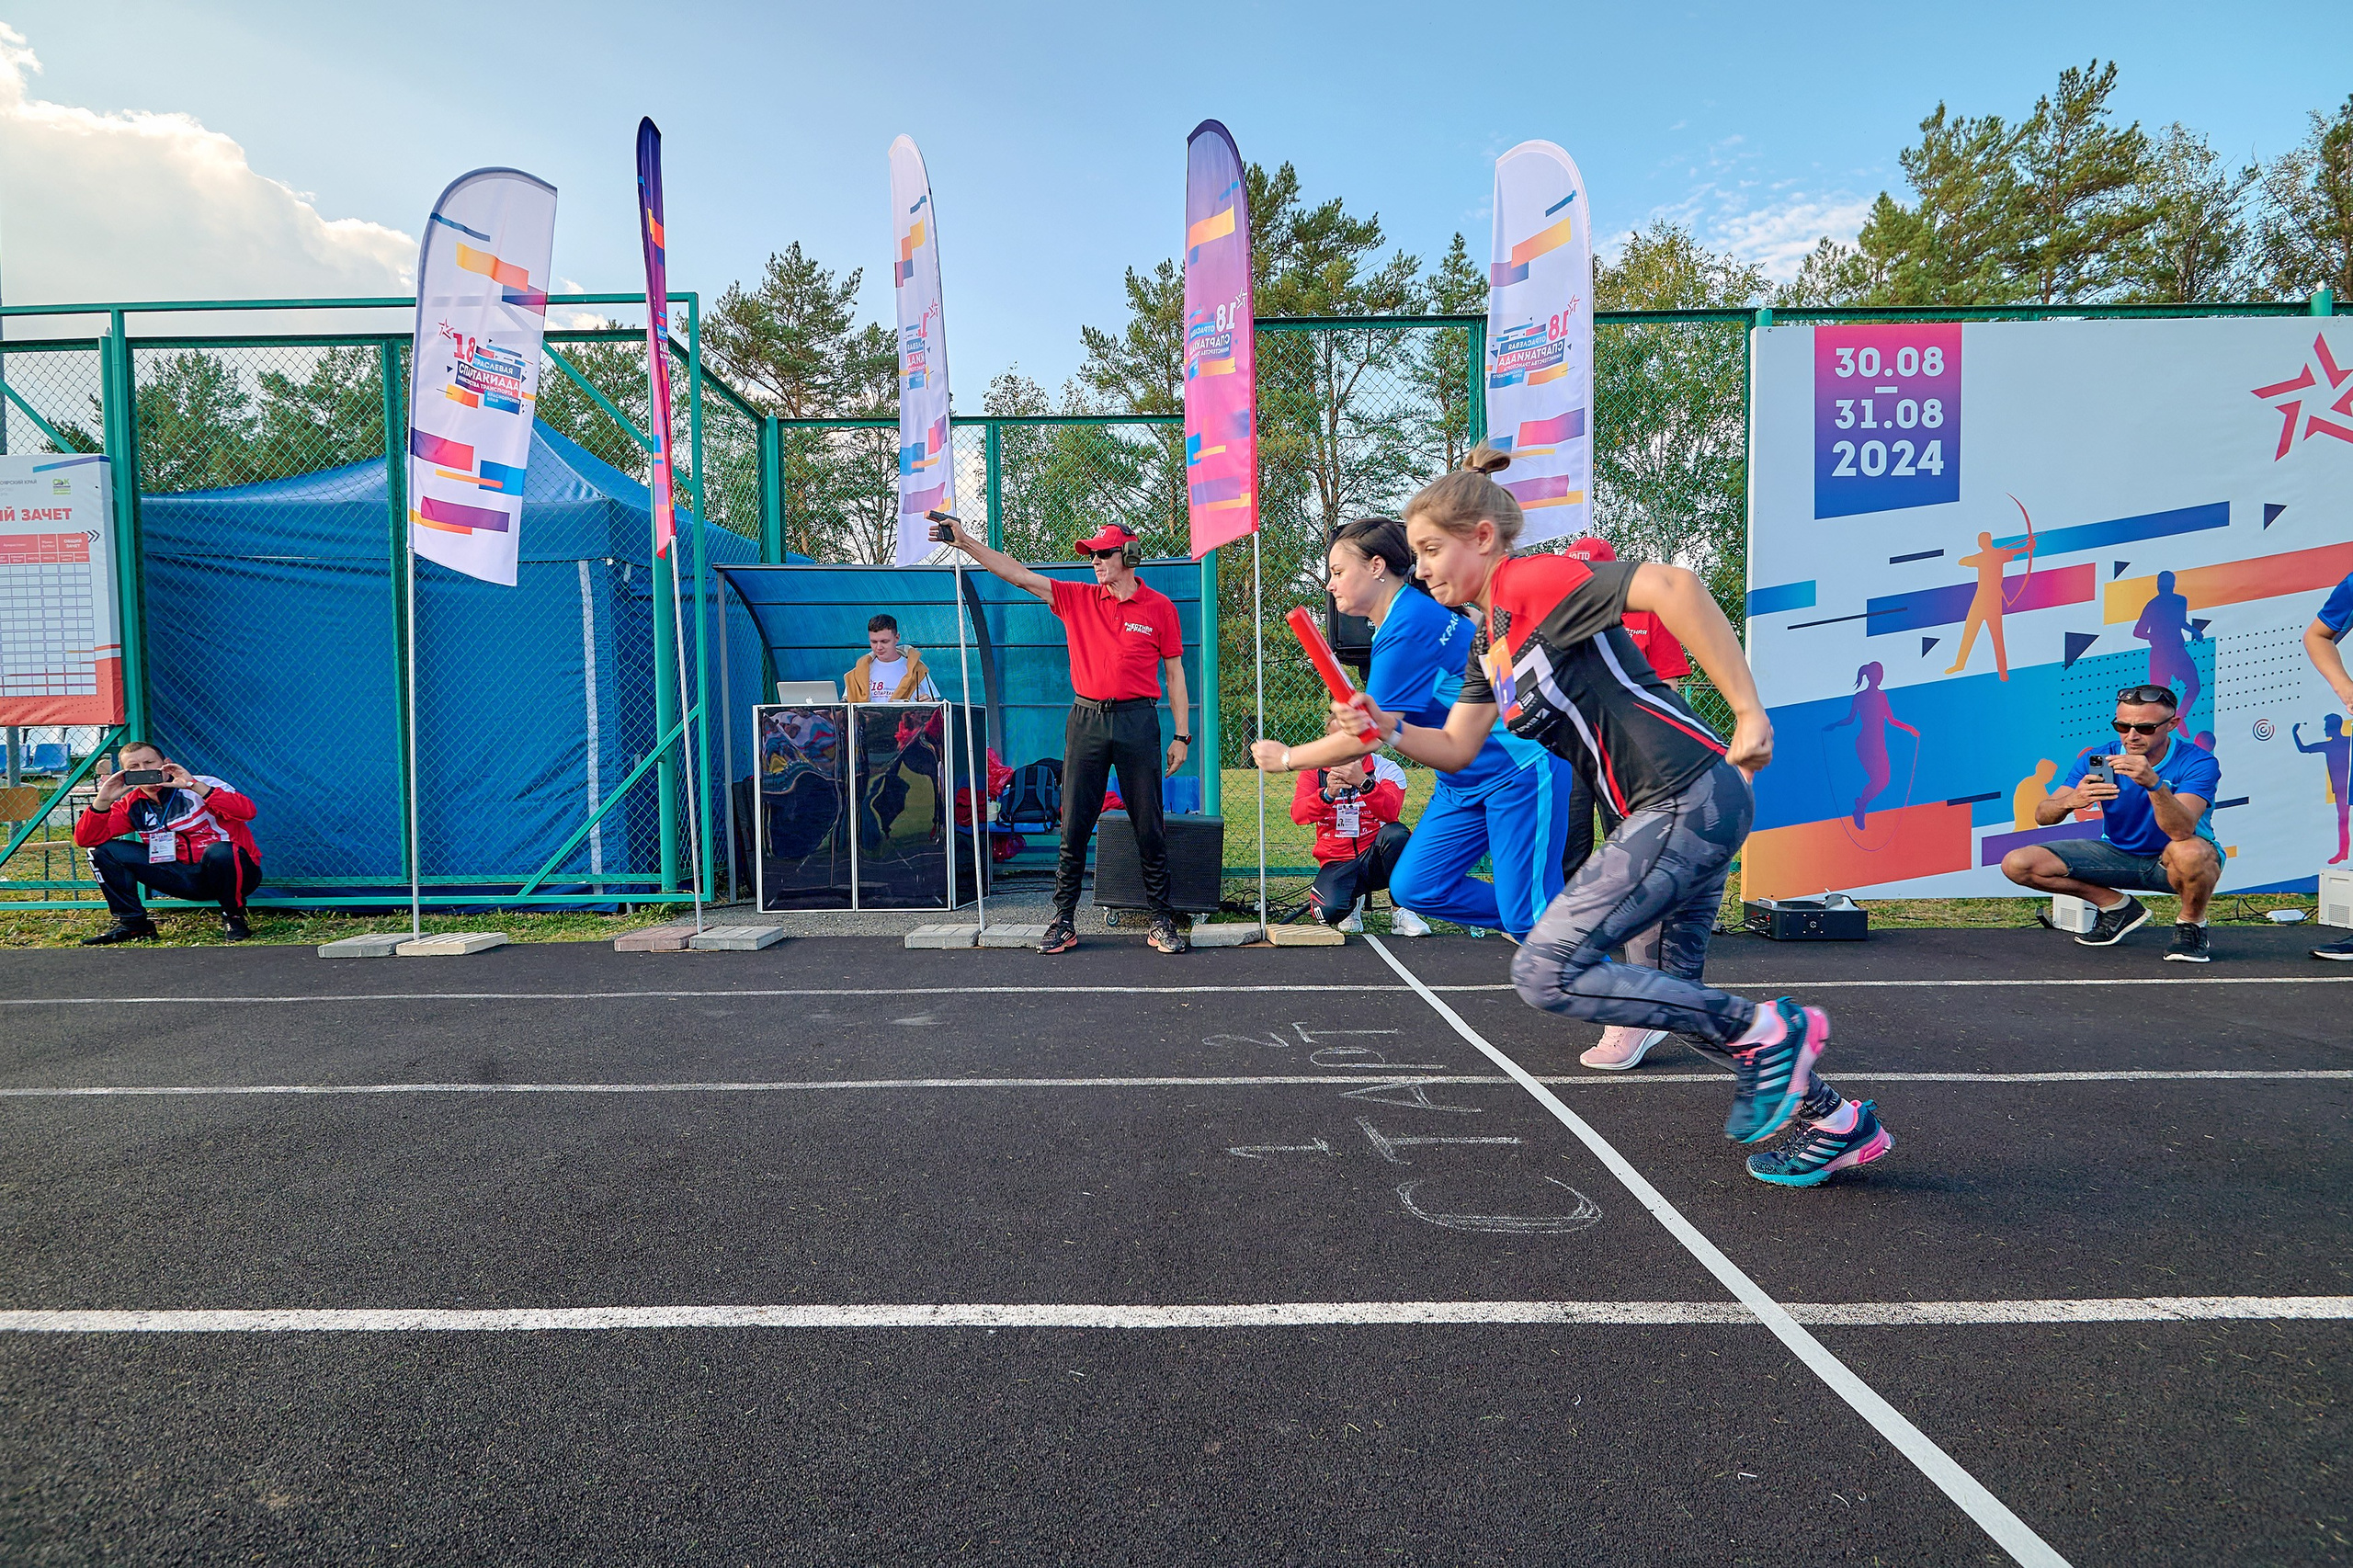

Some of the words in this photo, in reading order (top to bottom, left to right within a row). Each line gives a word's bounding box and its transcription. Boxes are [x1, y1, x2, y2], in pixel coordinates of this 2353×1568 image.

[453, 333, 476, 363] 18
[1835, 347, 1944, 378] 30.08
[1835, 398, 1944, 429] 31.08
[1831, 439, 1944, 477] 2024
[21, 507, 73, 521] ЗАЧЕТ
[871, 681, 884, 691] 18
